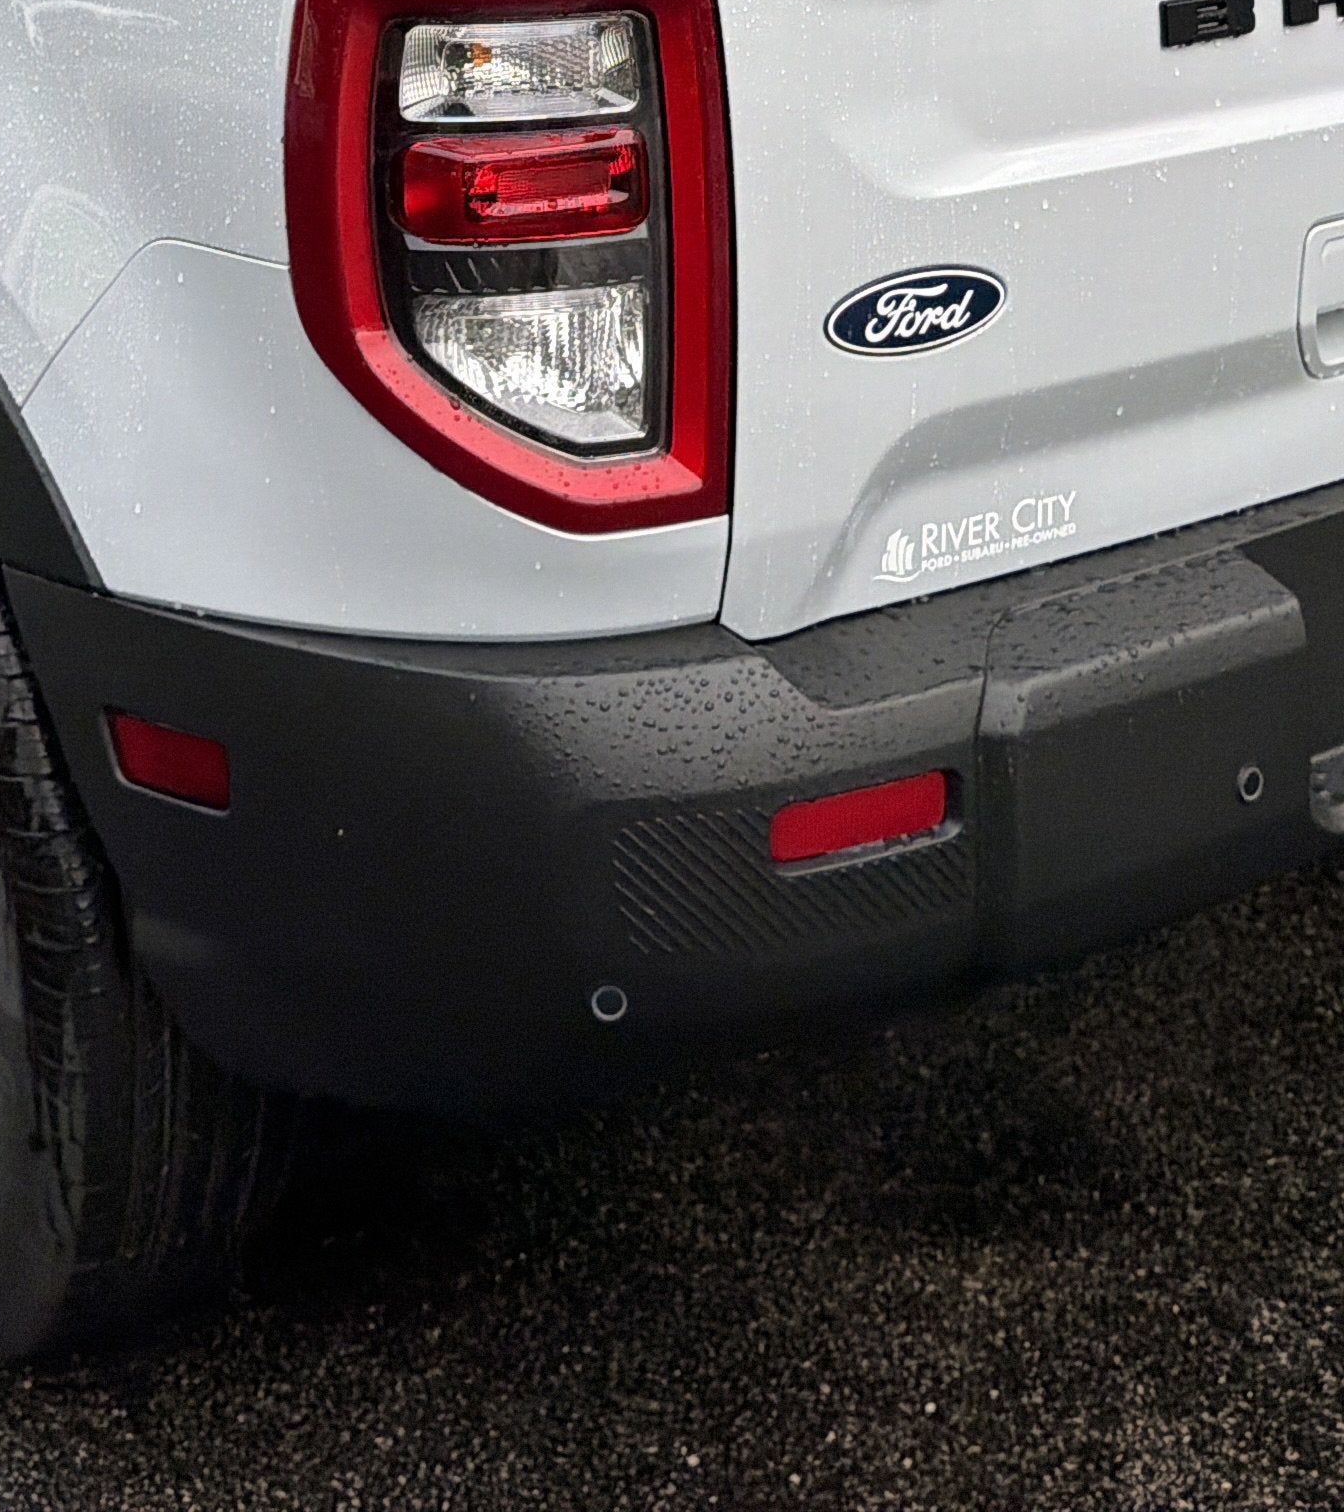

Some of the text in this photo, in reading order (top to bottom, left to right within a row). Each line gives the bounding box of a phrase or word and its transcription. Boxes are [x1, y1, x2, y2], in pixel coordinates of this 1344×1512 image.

[864, 282, 975, 344] Ford
[921, 490, 1077, 558] RIVER CITY
[921, 521, 1077, 573] FORD SUBARU PRE-OWNED
